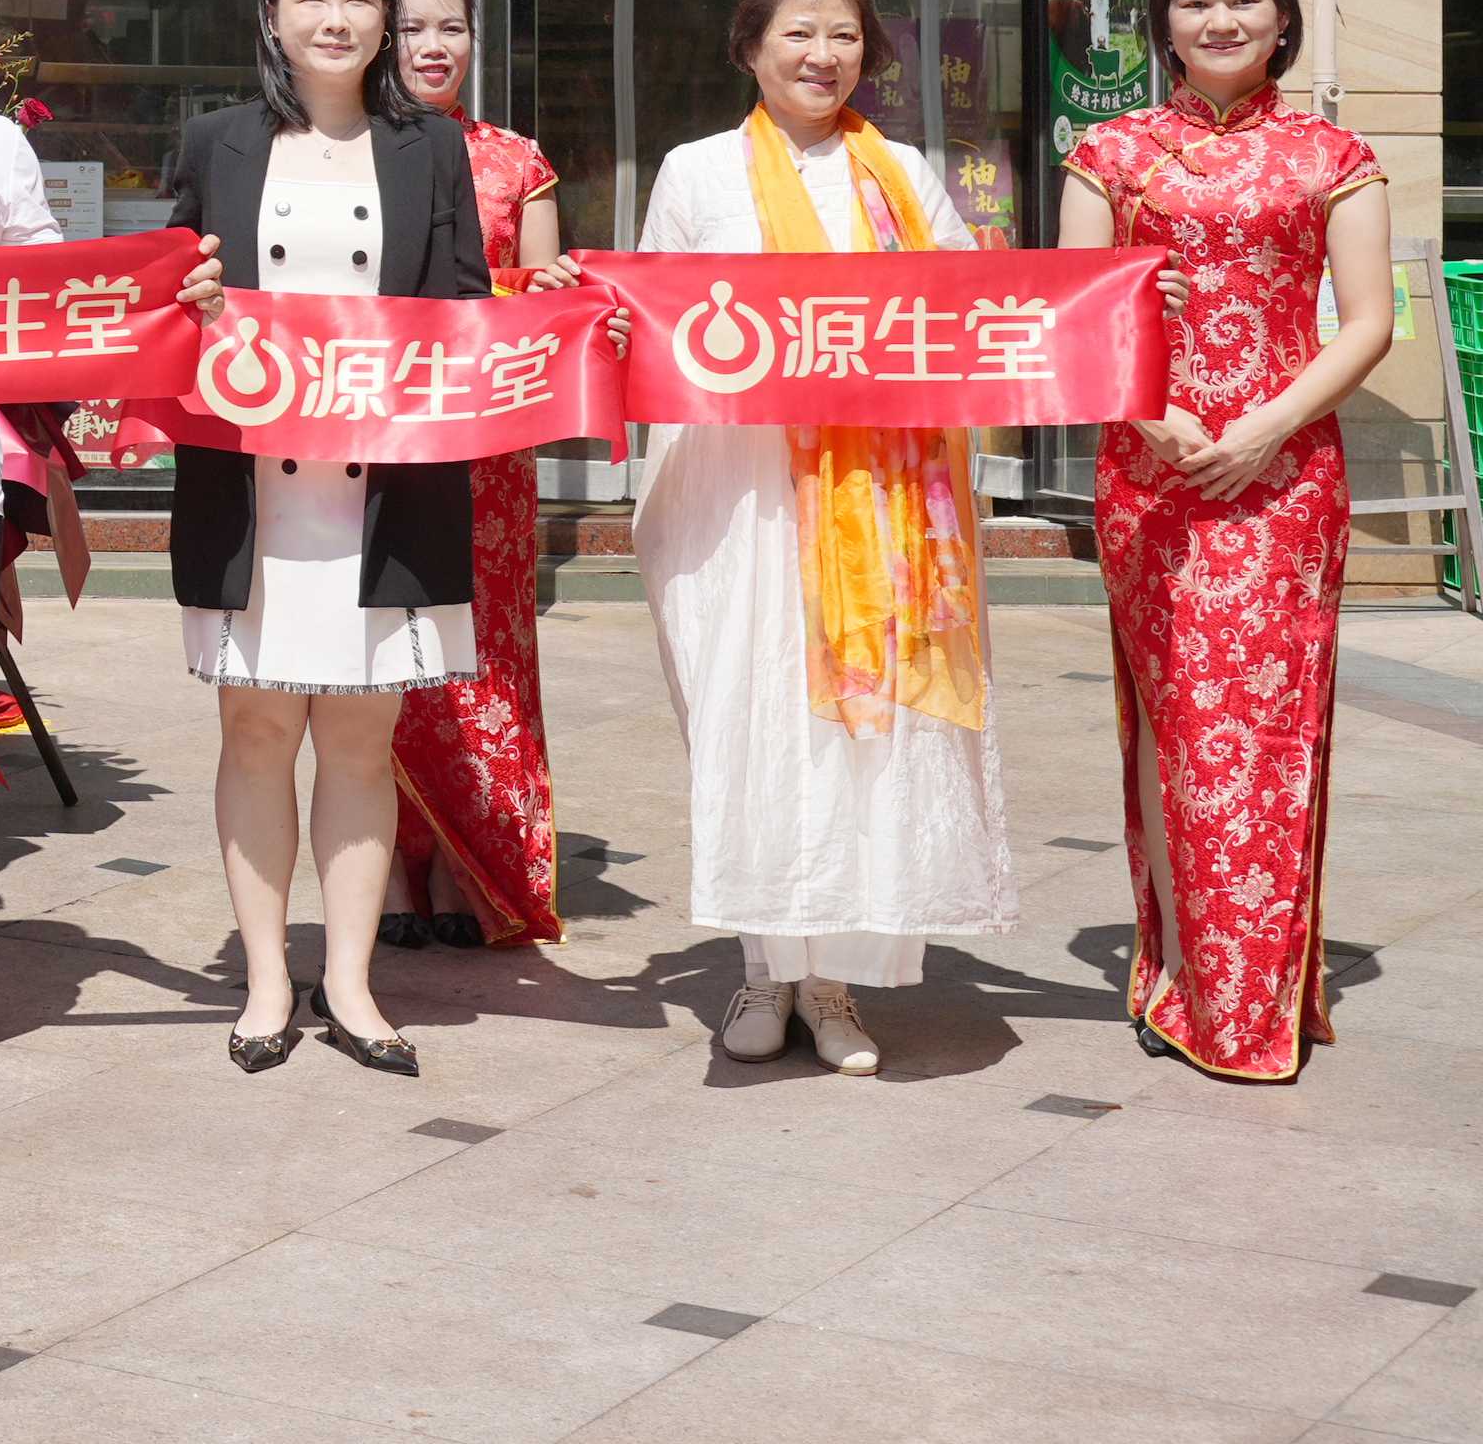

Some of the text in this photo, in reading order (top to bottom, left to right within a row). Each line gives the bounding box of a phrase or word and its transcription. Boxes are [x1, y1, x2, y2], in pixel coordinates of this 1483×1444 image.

[299, 331, 561, 422] 源生堂
[778, 294, 1056, 381] 源生堂
